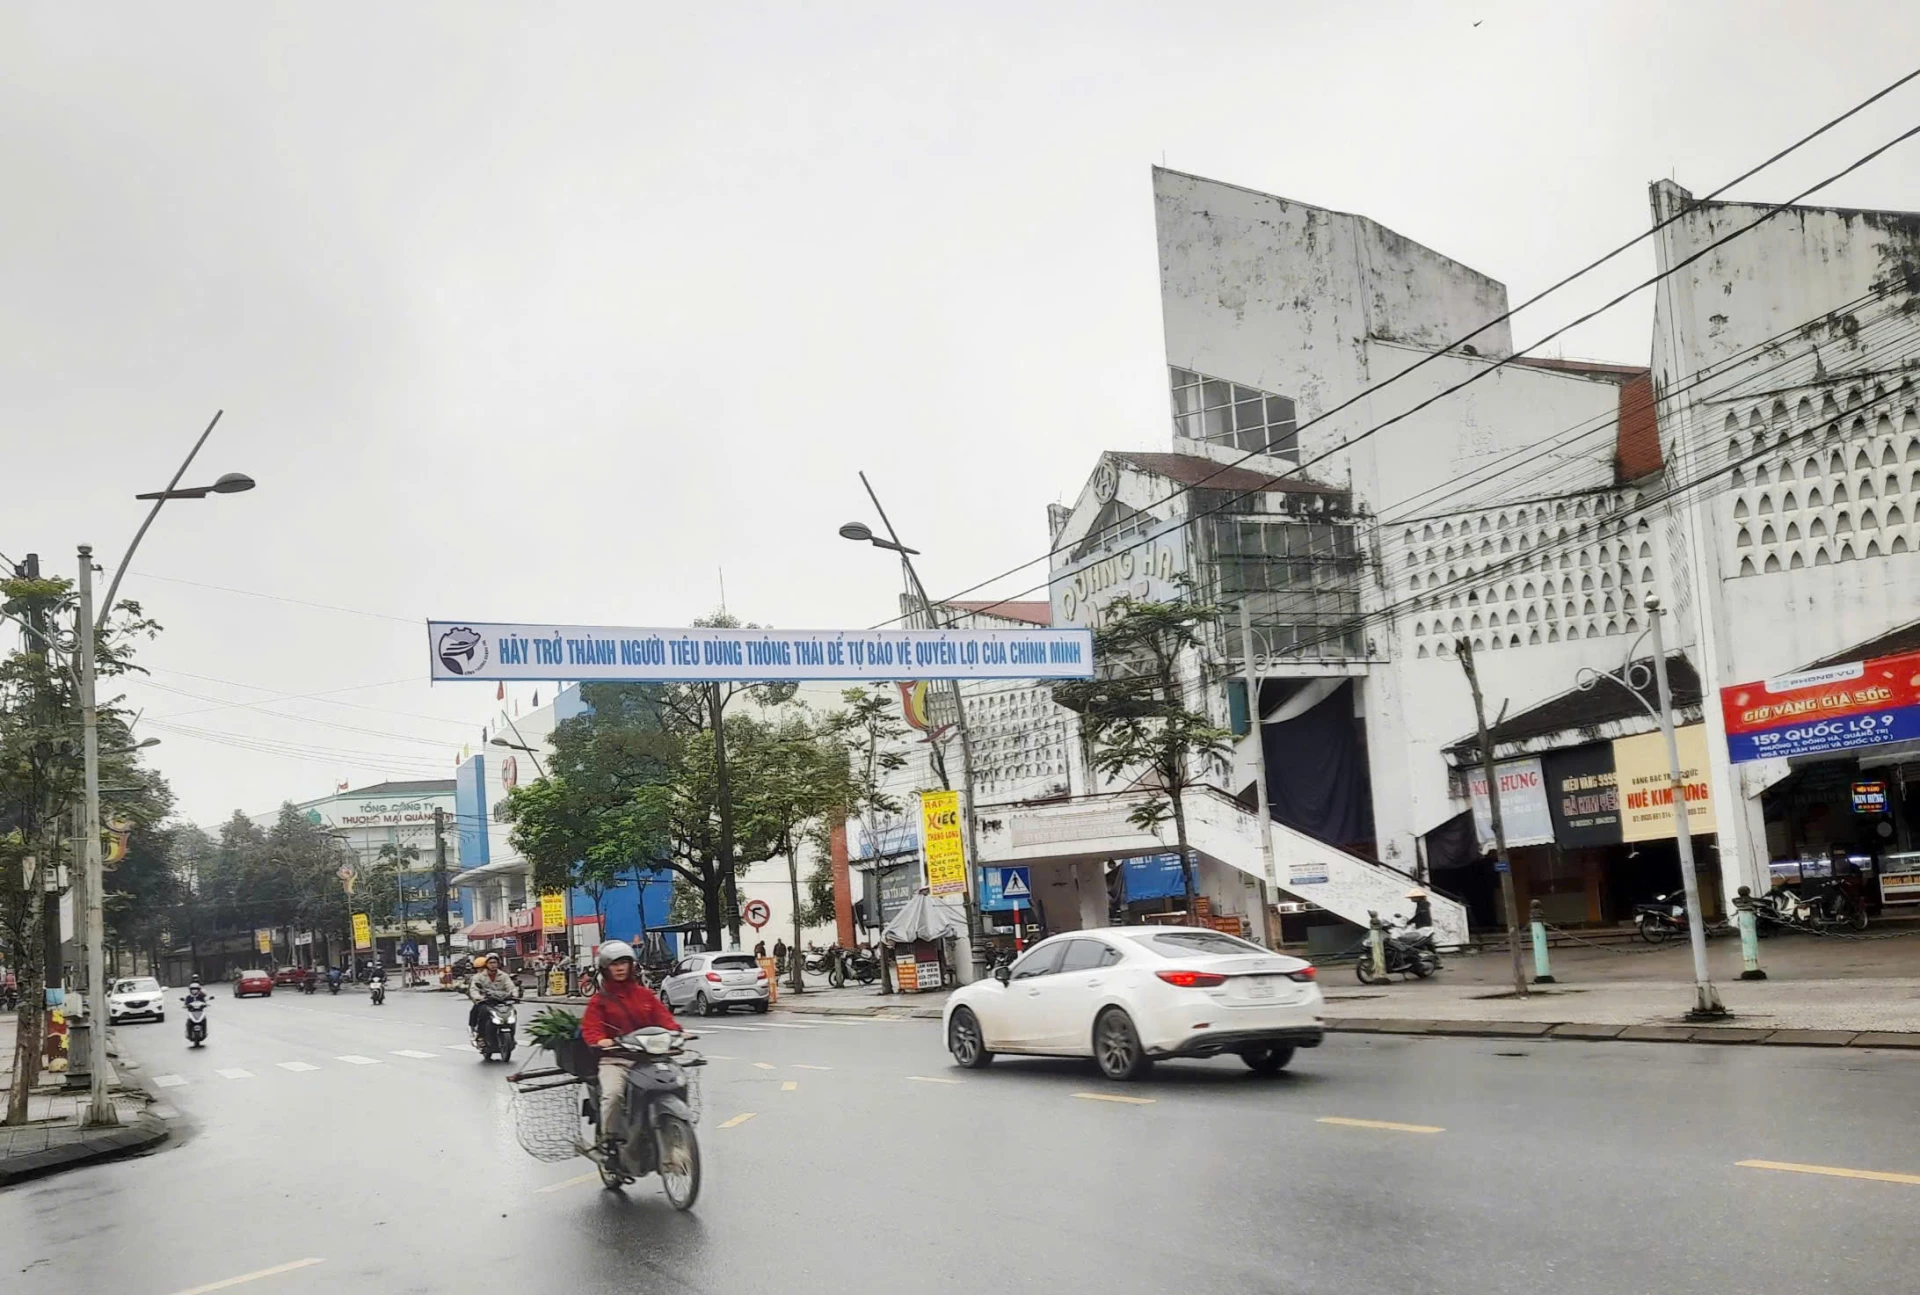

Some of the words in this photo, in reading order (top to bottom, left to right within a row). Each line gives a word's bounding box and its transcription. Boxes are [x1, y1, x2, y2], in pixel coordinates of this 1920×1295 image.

[499, 633, 529, 665] HÃY
[533, 630, 563, 665] TRỞ
[567, 634, 616, 665] THÀNH
[621, 634, 665, 666] NGƯỜI
[669, 635, 699, 666] TIÊU
[704, 635, 742, 666] DÙNG
[746, 636, 791, 666] THÔNG
[794, 636, 824, 666] THÁI
[827, 632, 845, 666] ĐỂ
[847, 638, 864, 671] TỰ
[867, 633, 893, 666] BẢO
[896, 636, 912, 671] VỆ
[961, 639, 978, 670] LỢI
[983, 634, 1007, 665] CỦA
[1011, 637, 1047, 664] CHÍNH
[1050, 637, 1081, 664] MÌNH
[1791, 673, 1833, 685] PHONG
[1855, 686, 1892, 702] SỐC
[1751, 732, 1780, 746] 159
[1785, 721, 1844, 741] QUỐC
[1881, 715, 1894, 726] 9
[1651, 787, 1674, 806] KIM
[360, 801, 388, 813] TỔNG
[392, 801, 421, 812] CÔNG
[424, 802, 435, 811] TY
